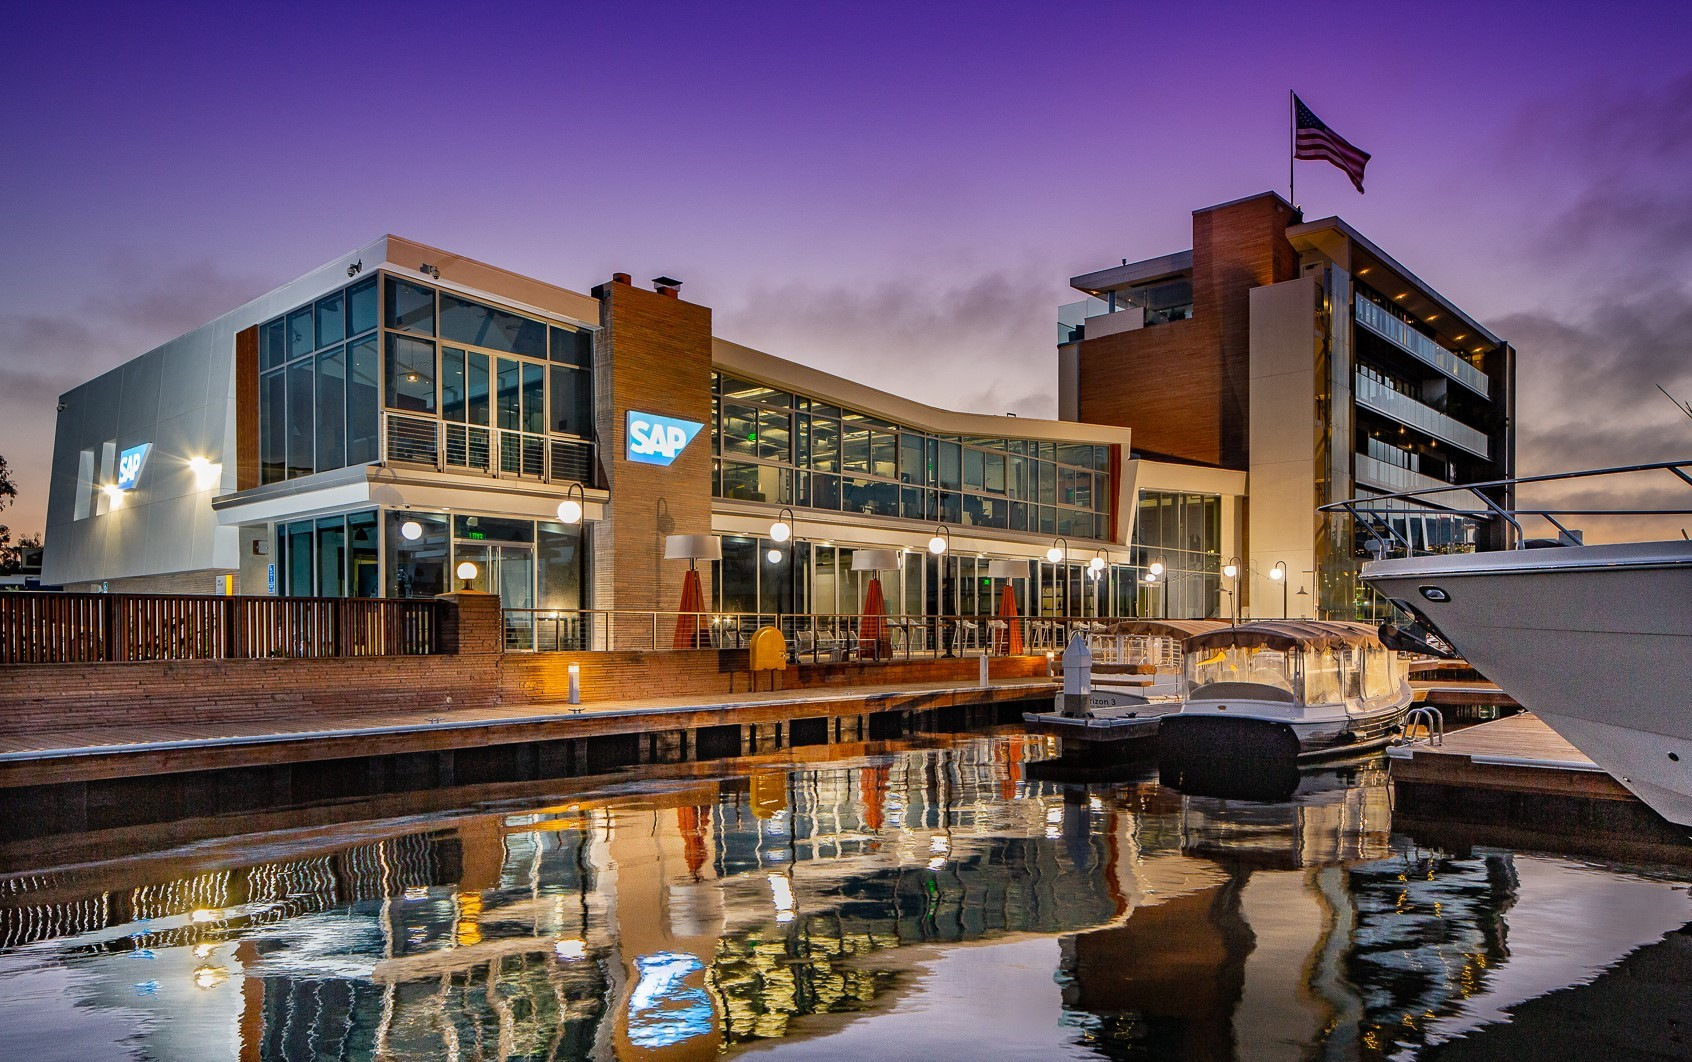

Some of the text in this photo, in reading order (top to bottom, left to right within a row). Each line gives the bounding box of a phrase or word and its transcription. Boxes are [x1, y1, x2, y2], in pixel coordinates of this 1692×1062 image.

[630, 420, 687, 458] SAP
[119, 453, 141, 484] SAP
[1089, 697, 1117, 706] rizon 3
